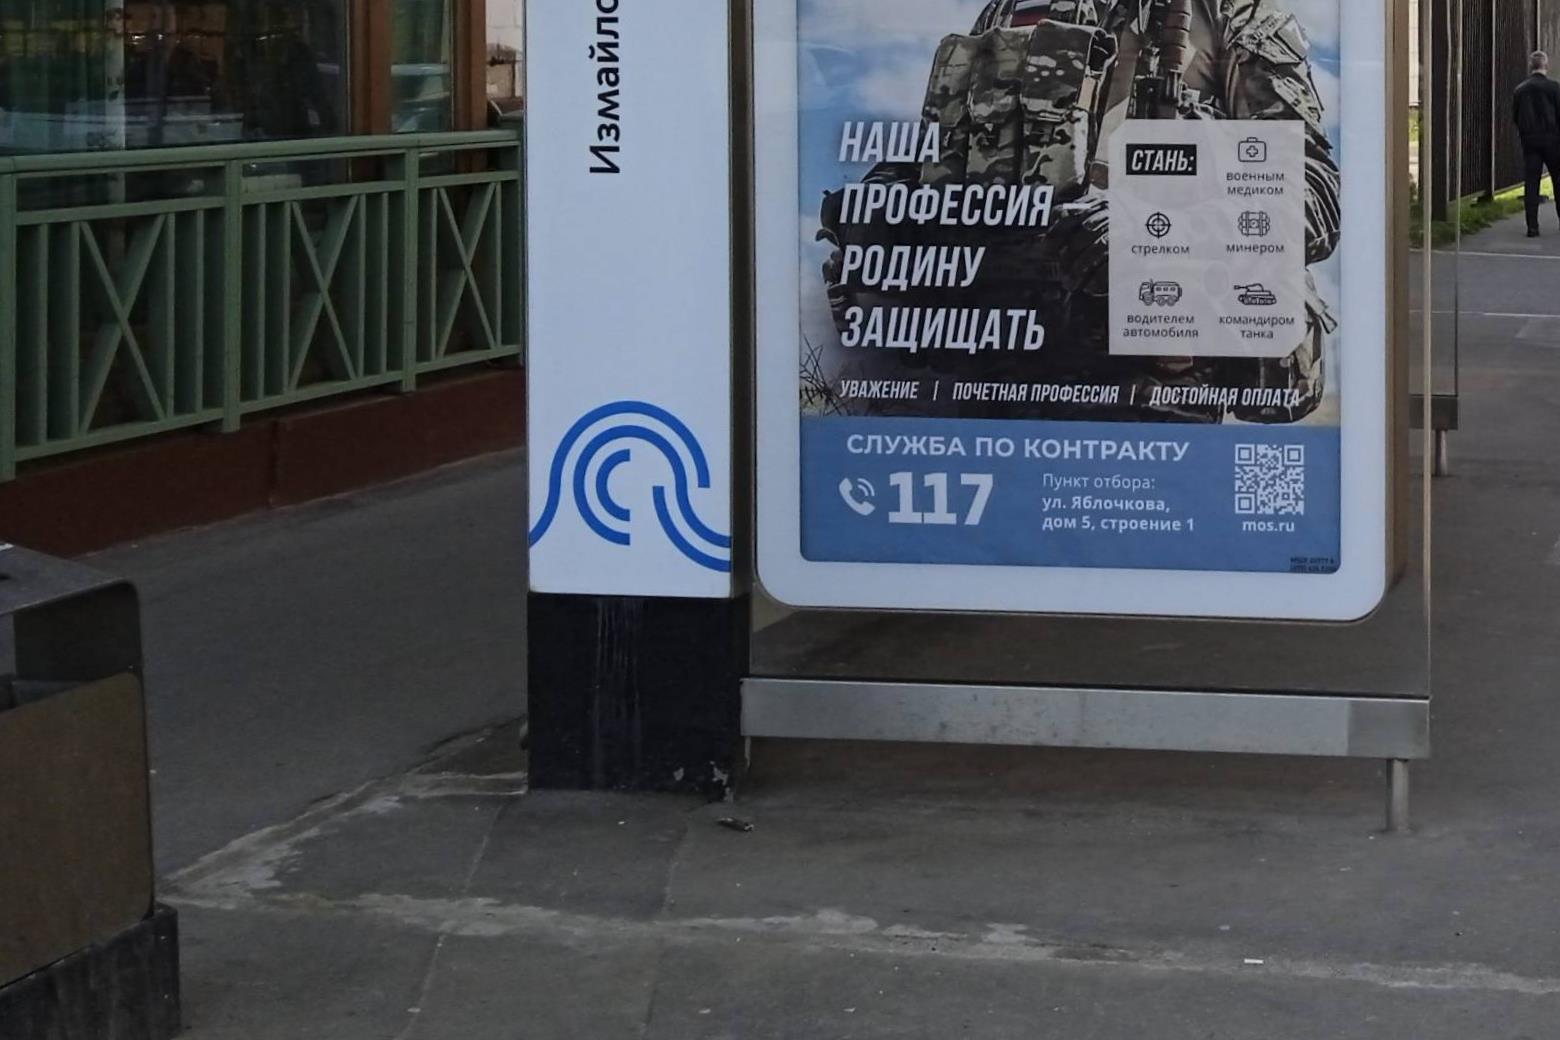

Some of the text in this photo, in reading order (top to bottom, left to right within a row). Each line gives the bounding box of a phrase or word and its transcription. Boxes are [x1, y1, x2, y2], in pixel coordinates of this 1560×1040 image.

[839, 121, 941, 163] НАША
[1131, 149, 1194, 172] СТАНЬ:
[1226, 172, 1285, 182] военным
[1226, 185, 1284, 196] медиком
[839, 183, 1055, 227] ПРОФЕССИЯ
[1131, 244, 1190, 255] стрелком
[1226, 244, 1285, 255] минером
[840, 244, 987, 292] РОДИНУ
[1127, 314, 1195, 325] водителем
[1218, 315, 1295, 327] командиром
[840, 306, 1046, 355] ЗАЩИЩАТЬ
[1122, 327, 1199, 338] автомобиля
[1240, 330, 1274, 340] танка
[839, 380, 919, 400] УВАЖЕНИЕ
[952, 381, 1119, 404] ПОЧЕТНАЯ ПРОФЕССИЯ
[1149, 384, 1301, 408] ДОСТОЙНАЯ ОПЛАТА
[846, 434, 1190, 462] СЛУЖБА ПО КОНТРАКТУ
[1042, 472, 1156, 490] Пункт отбора:
[887, 471, 994, 526] 117
[1042, 496, 1171, 513] ул. Яблочкова,
[1042, 517, 1195, 534] дом 5, строение 1
[1242, 521, 1296, 533] mos.ru
